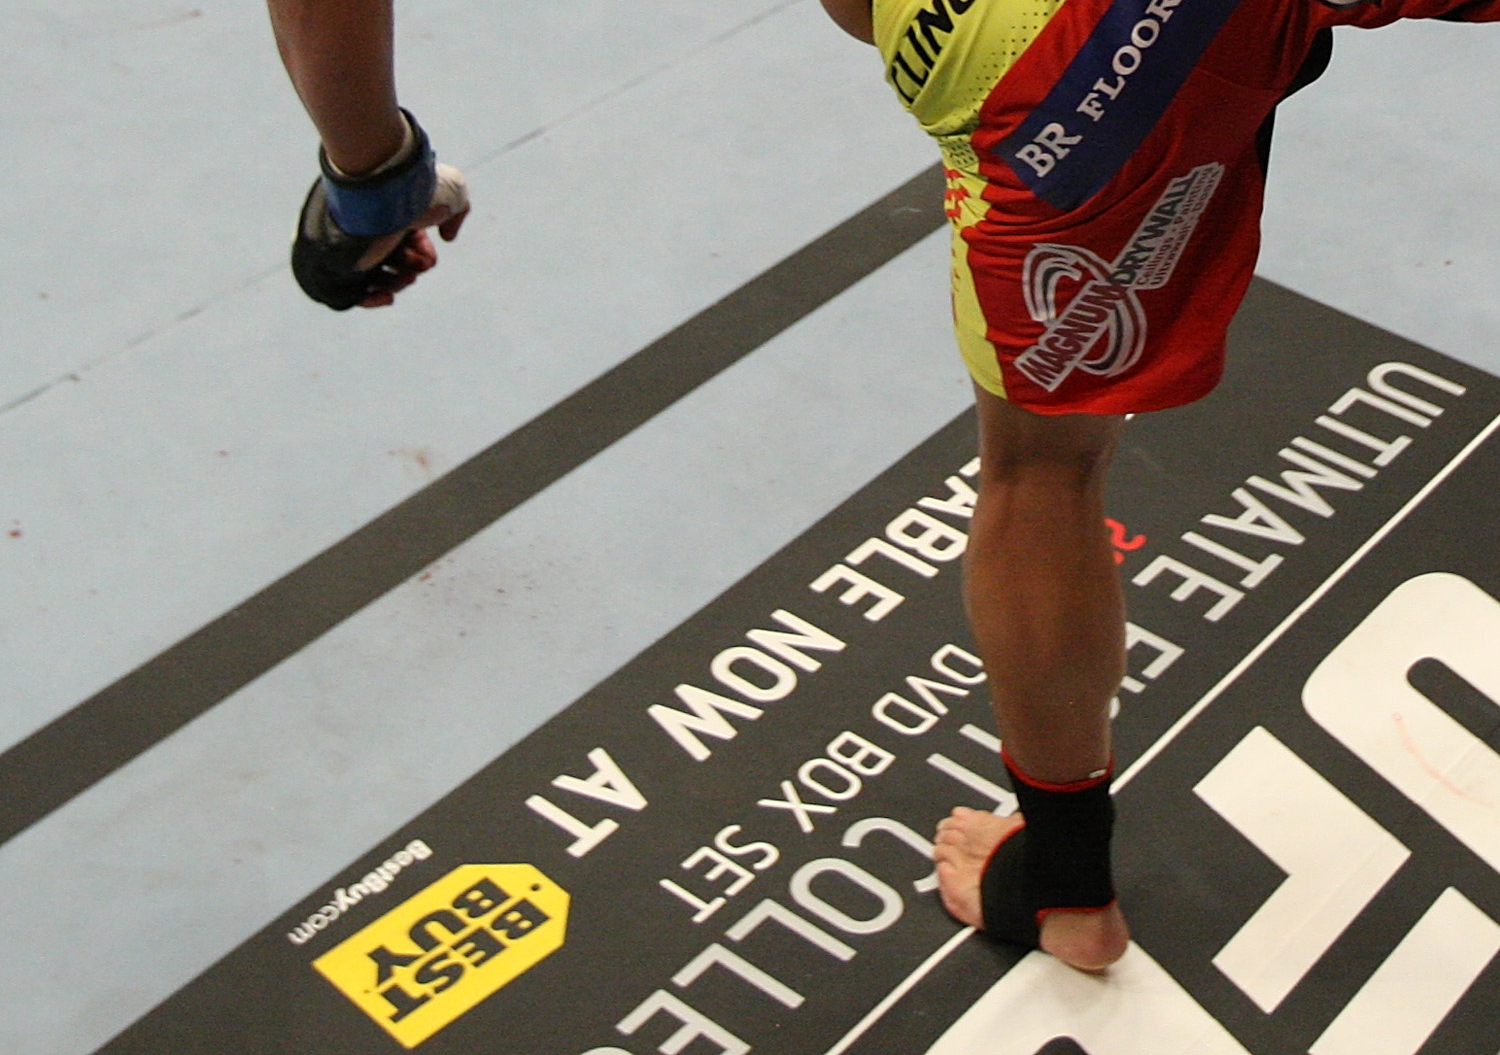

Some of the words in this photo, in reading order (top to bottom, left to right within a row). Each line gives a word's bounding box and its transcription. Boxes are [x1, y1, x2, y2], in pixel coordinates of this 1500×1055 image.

[1014, 121, 1083, 179] BR
[1105, 170, 1200, 286] DRYWALL
[1018, 279, 1129, 384] MAGNUM
[1131, 361, 1467, 623] ULTIMATE
[646, 608, 848, 762] NOW
[871, 642, 988, 735] DVD
[524, 747, 649, 859] AT
[756, 730, 897, 834] BOX
[658, 824, 781, 924] SET
[366, 876, 512, 988] BUY
[380, 896, 552, 1024] BEST
[578, 815, 945, 1055] COLLE
